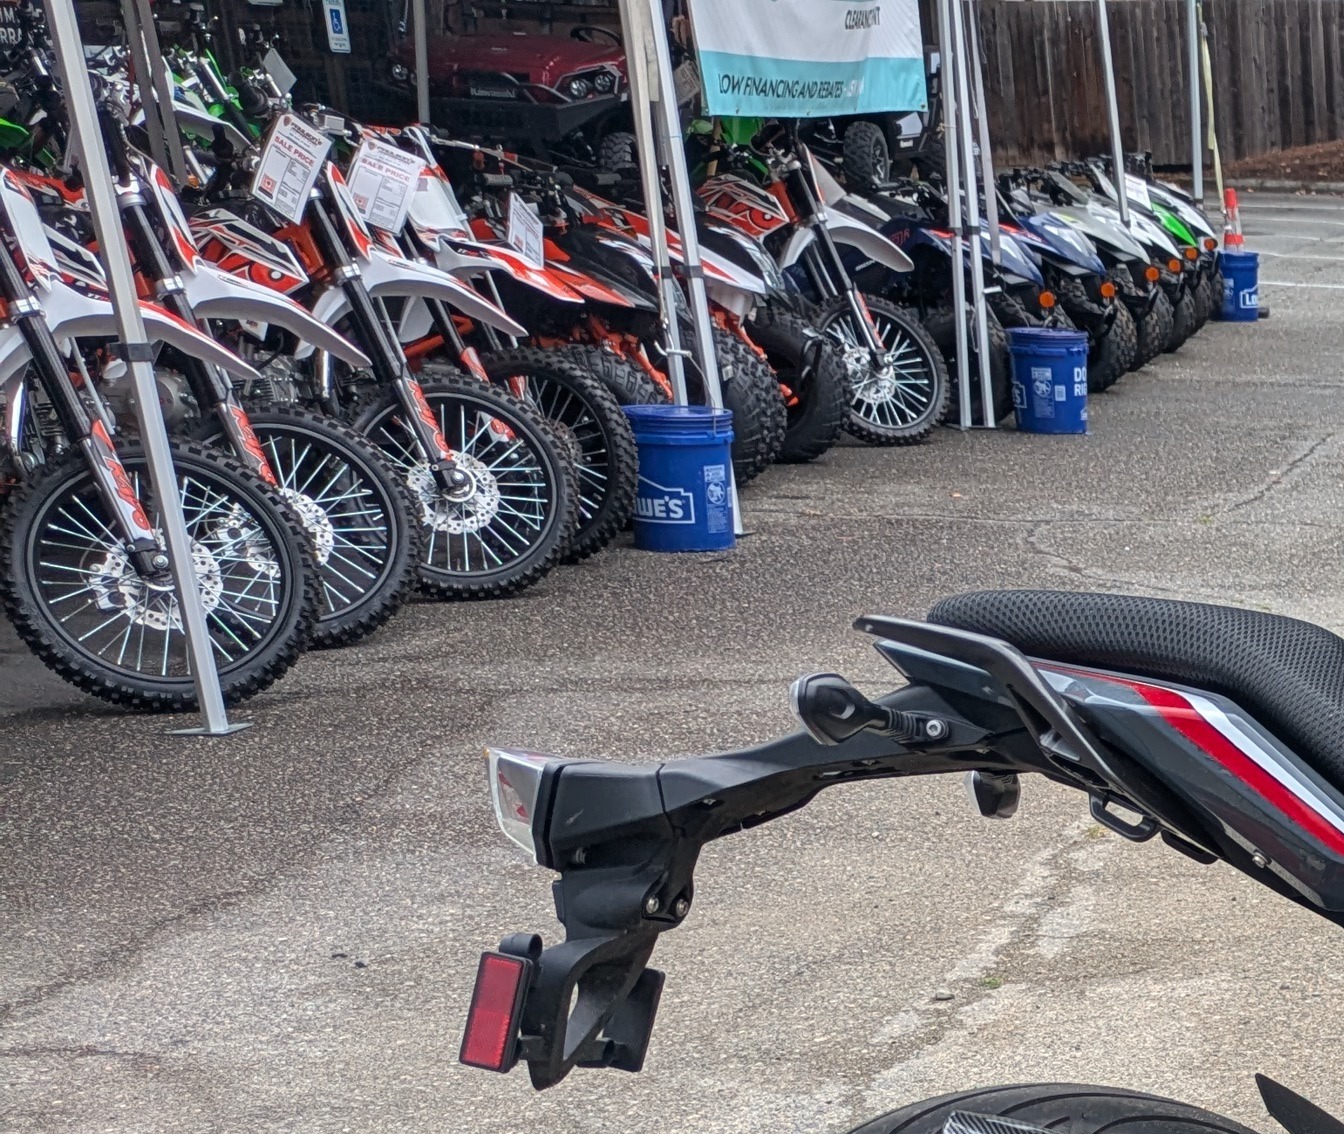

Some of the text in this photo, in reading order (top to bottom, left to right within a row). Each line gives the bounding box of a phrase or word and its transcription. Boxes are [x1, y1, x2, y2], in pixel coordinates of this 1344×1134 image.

[718, 73, 744, 95] LOW
[744, 76, 799, 99] FINANCING
[799, 80, 819, 99] AND
[273, 134, 315, 168] SALE PRICE
[361, 157, 410, 183] SALE PRICE
[633, 495, 684, 519] WE'S
